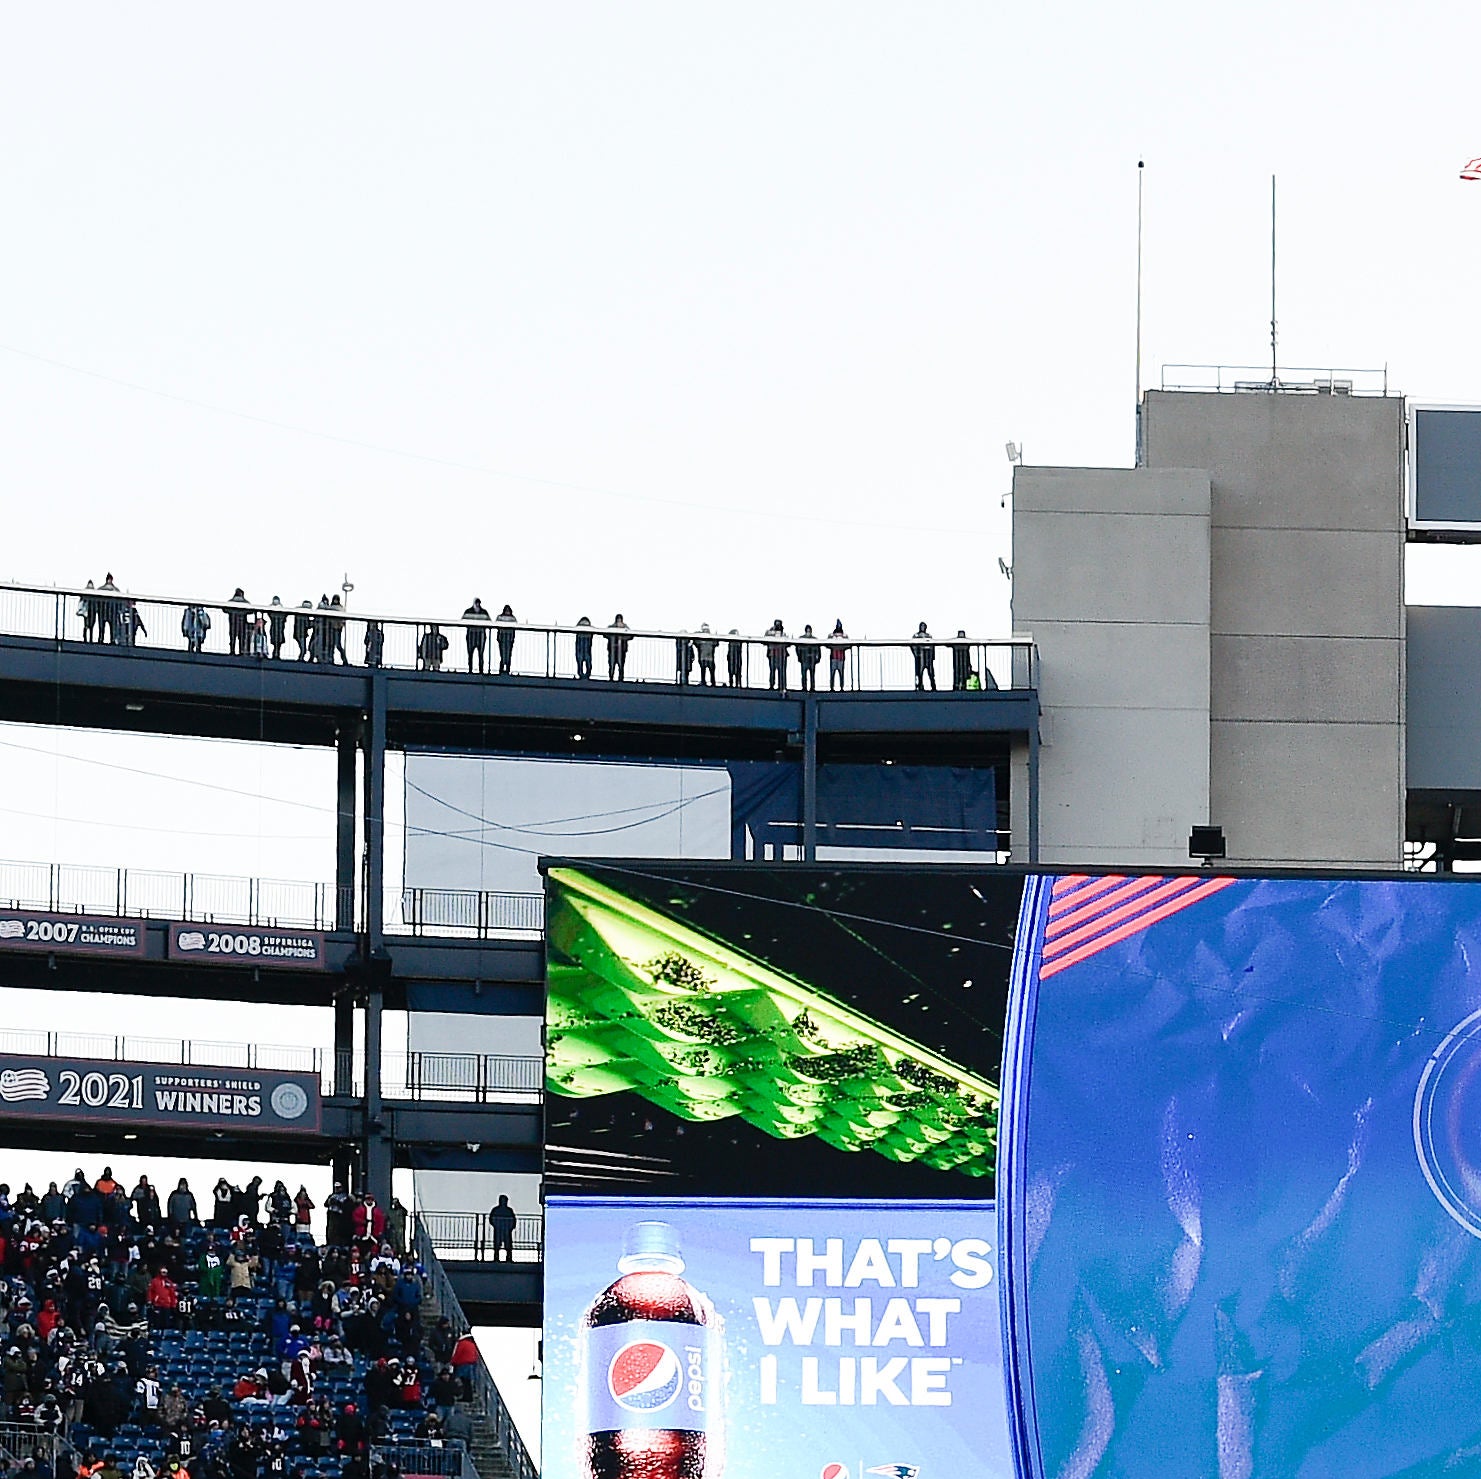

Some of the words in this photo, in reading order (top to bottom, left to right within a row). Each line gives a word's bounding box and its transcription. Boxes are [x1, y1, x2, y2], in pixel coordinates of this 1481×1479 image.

[26, 921, 79, 943] 2007
[80, 933, 137, 947] CHAMPIONS
[264, 937, 314, 948] SUPERLIGA
[208, 933, 261, 955] 2008
[261, 945, 316, 959] CHAMPIONS
[58, 1070, 144, 1110] 2021
[155, 1076, 222, 1088] SUPPORTERS'
[225, 1080, 261, 1091] SHIELD
[155, 1091, 262, 1116] WINNERS
[749, 1237, 994, 1290] THAT'S
[752, 1297, 961, 1347] WHAT
[687, 1344, 706, 1412] pepsi
[759, 1354, 778, 1405] I
[800, 1357, 952, 1407] LIKE
